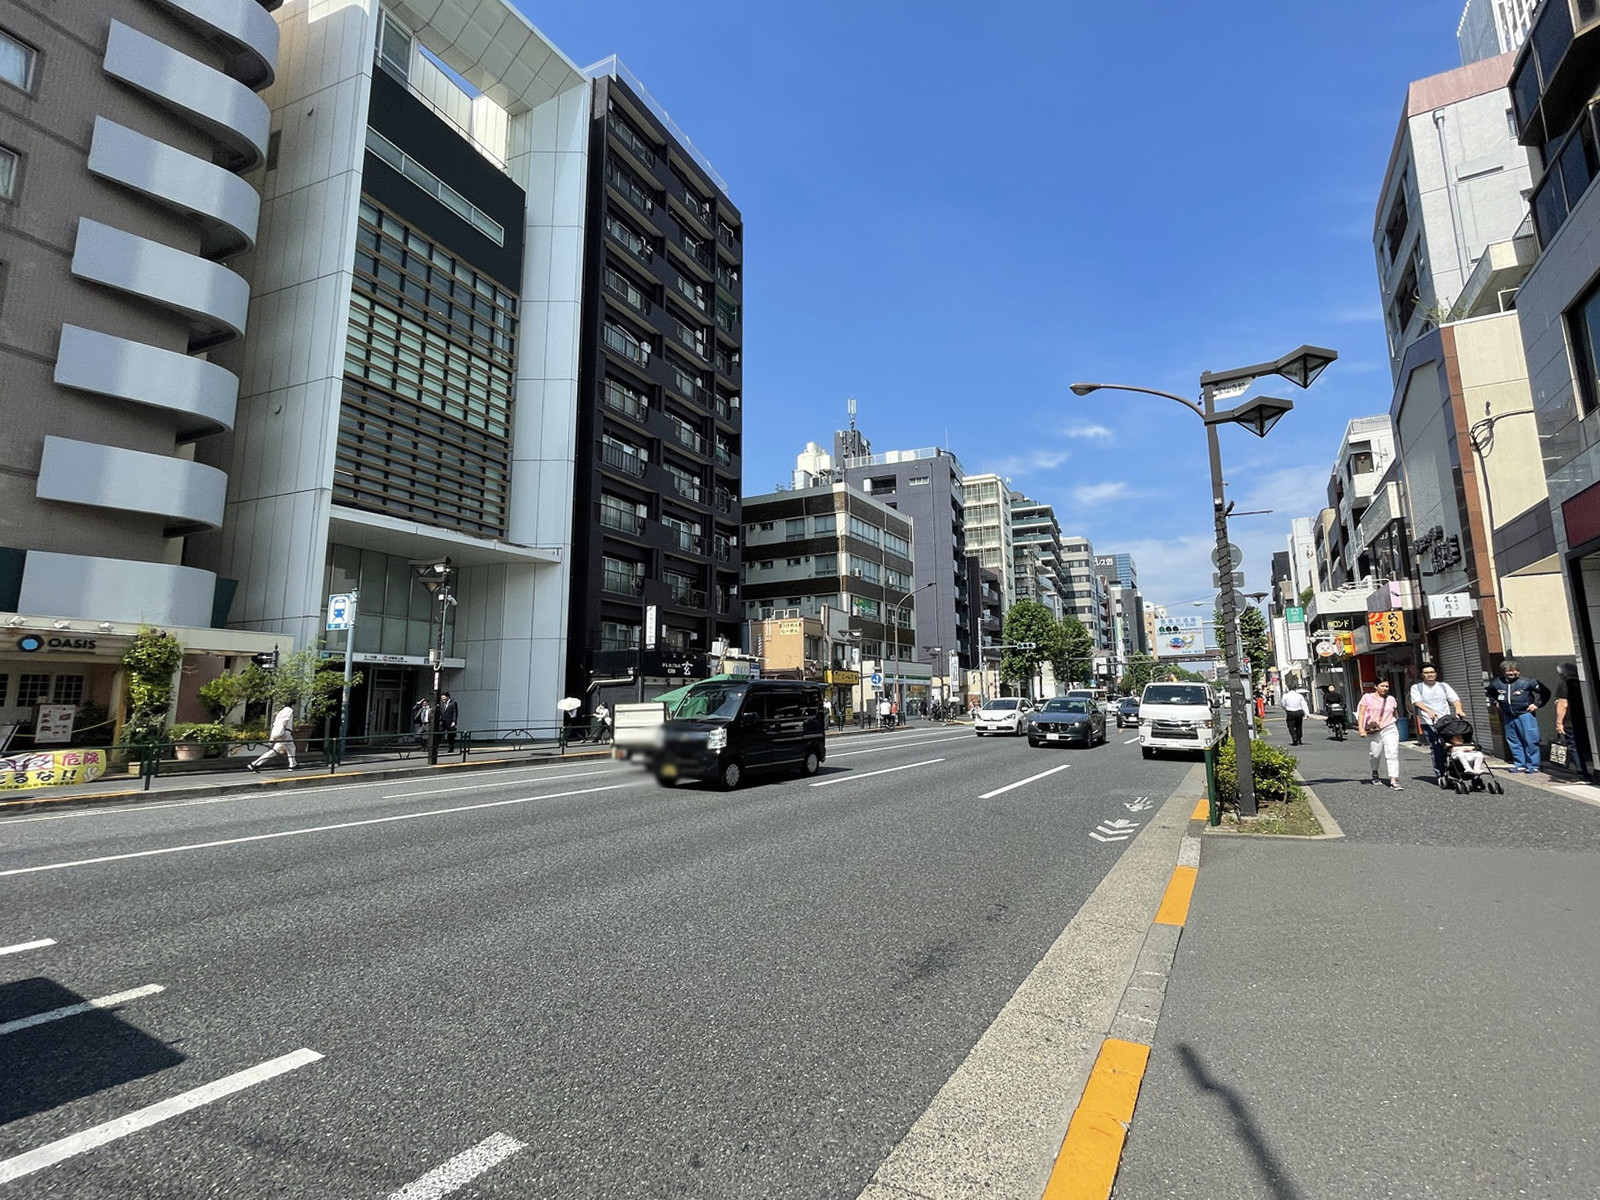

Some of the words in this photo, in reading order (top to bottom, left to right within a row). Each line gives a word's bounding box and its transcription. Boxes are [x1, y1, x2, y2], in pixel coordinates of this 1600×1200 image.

[48, 638, 97, 650] OASIS
[681, 660, 694, 676] 玄
[62, 751, 100, 767] 危険
